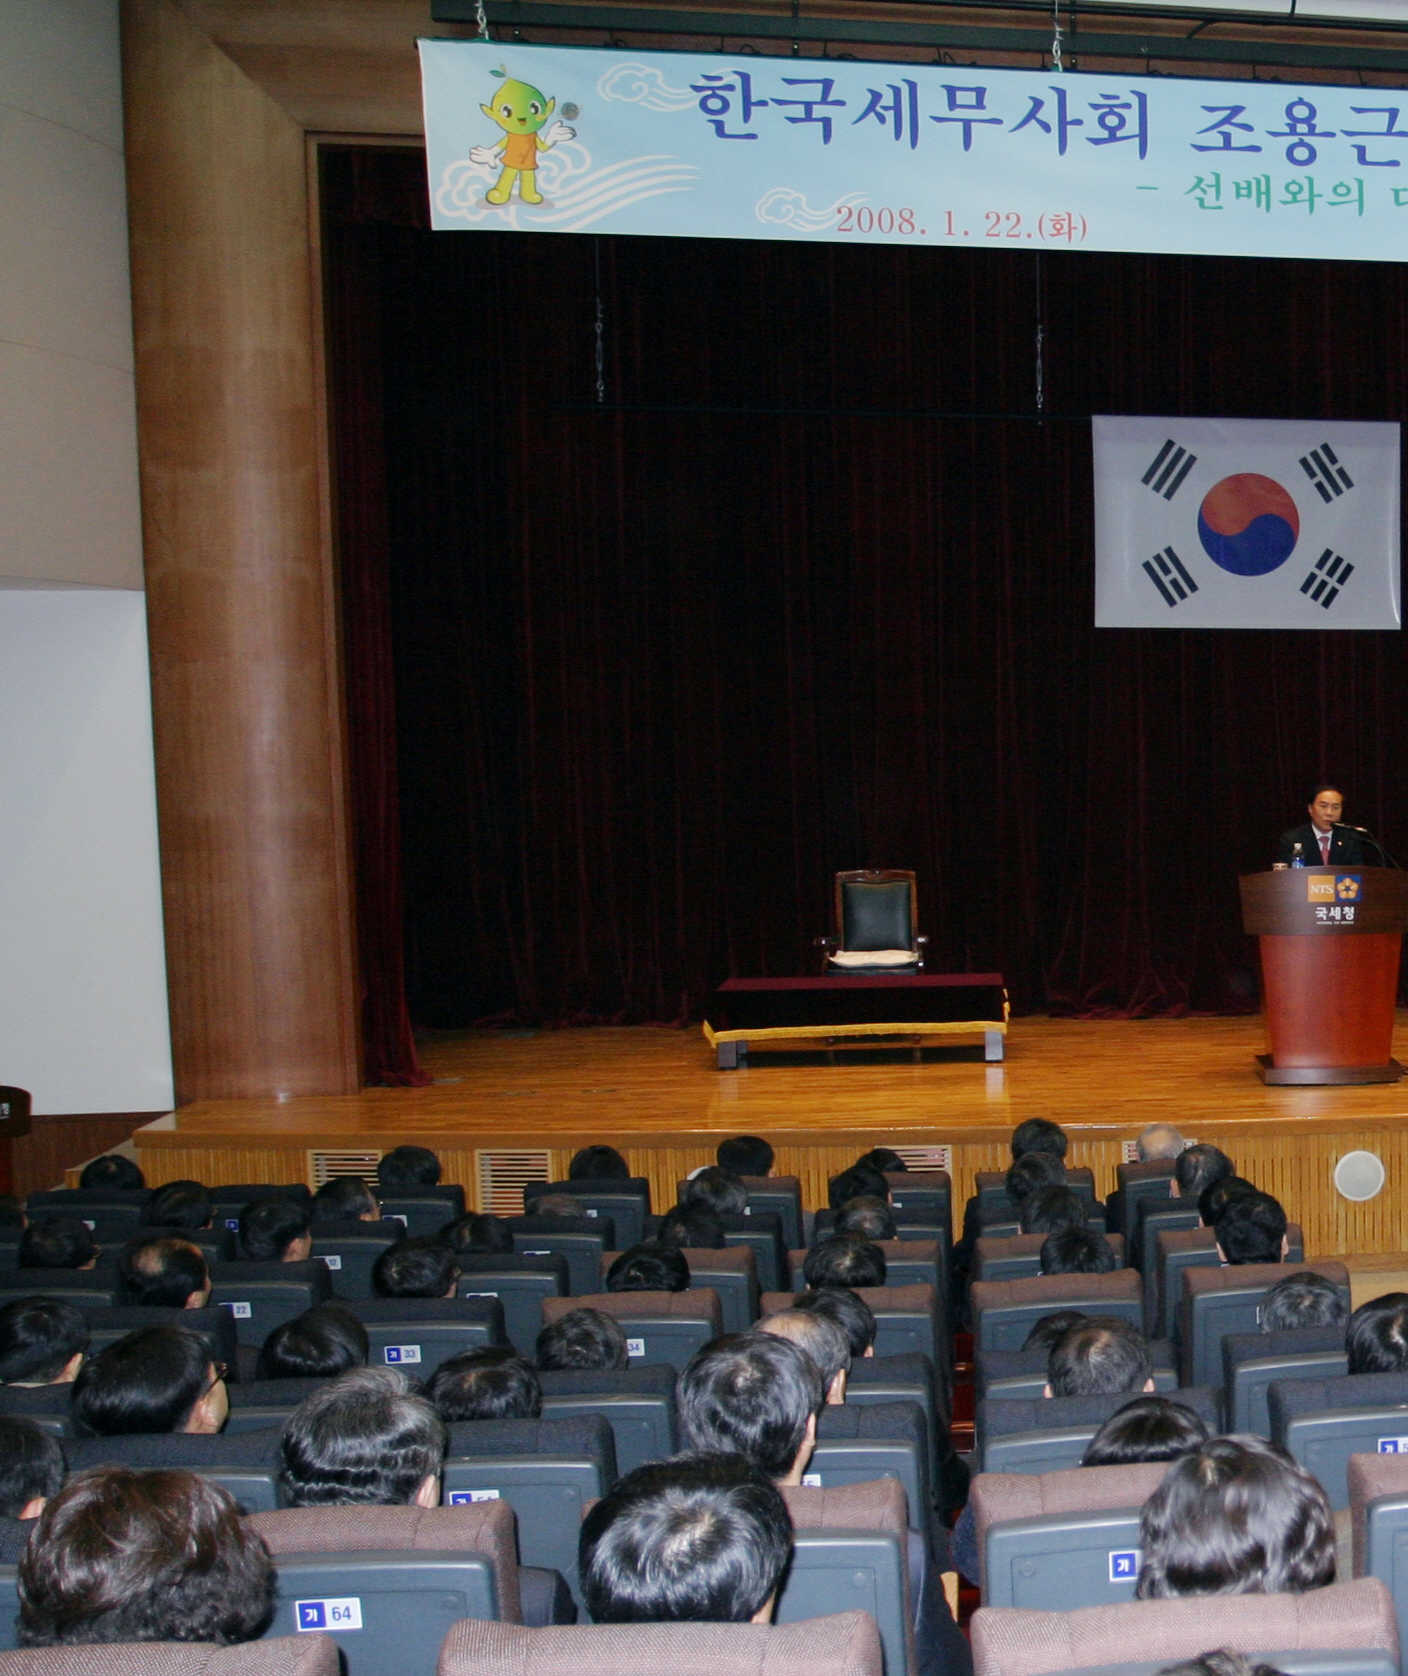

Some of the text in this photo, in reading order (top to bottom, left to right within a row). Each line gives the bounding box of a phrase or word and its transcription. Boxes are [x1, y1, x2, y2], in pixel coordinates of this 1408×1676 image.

[690, 71, 1148, 161] 한국세무사회
[1183, 171, 1366, 217] 선배와의
[836, 206, 927, 235] 2008.
[1315, 906, 1355, 921] 국세청
[1117, 1558, 1130, 1572] 가
[306, 1605, 352, 1622] 가 64
